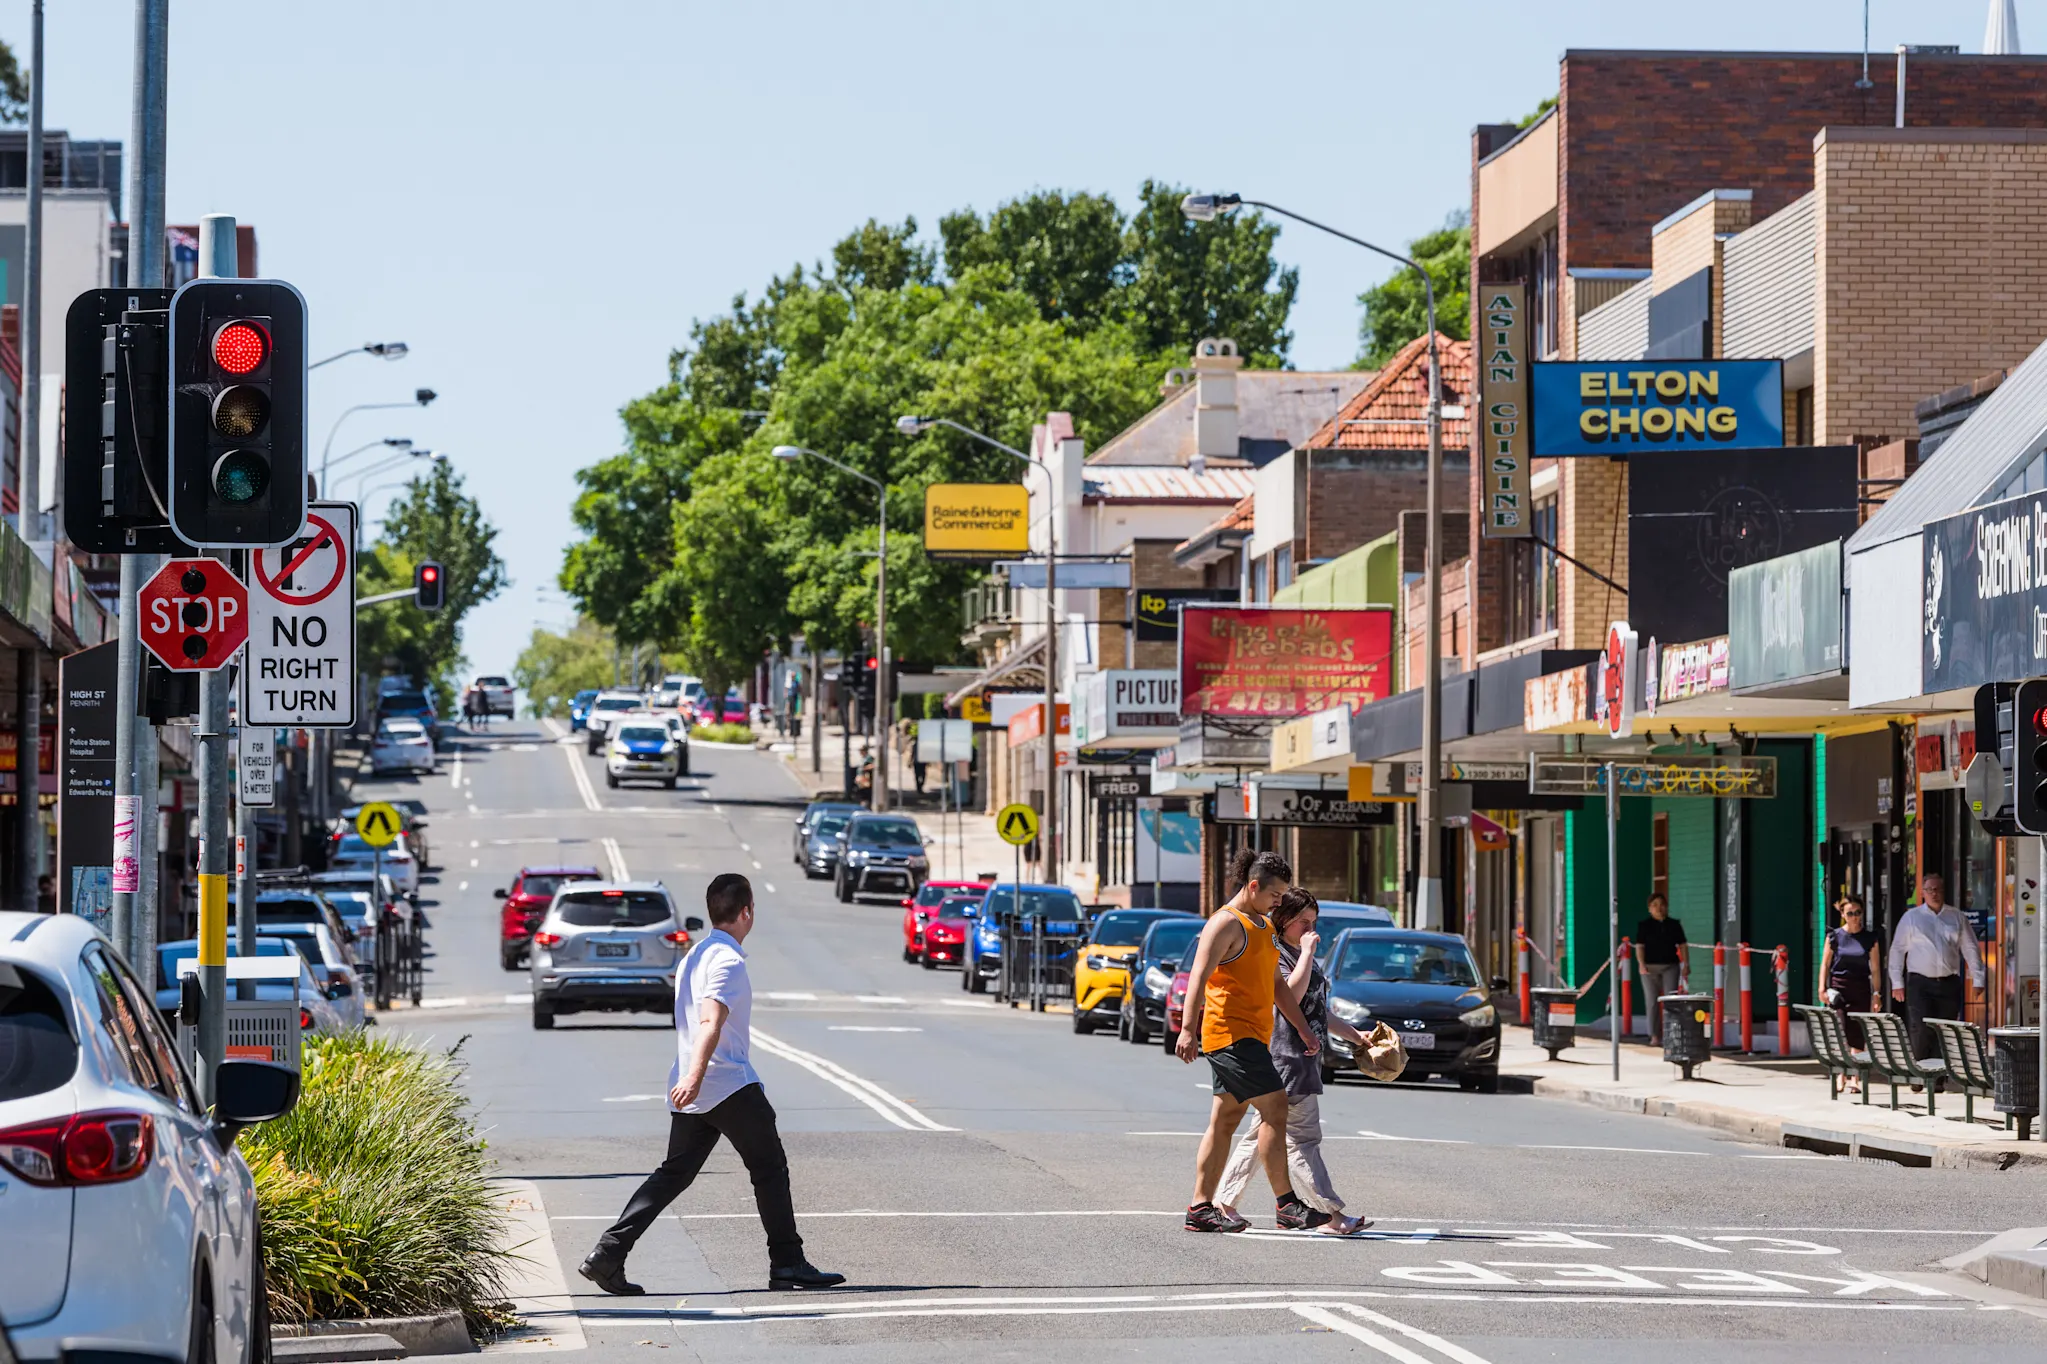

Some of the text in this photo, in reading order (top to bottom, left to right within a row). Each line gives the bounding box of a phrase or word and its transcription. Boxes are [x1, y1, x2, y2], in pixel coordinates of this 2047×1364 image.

[1580, 371, 1719, 404] ELTON
[1486, 293, 1521, 528] ASIAN CUISINE
[1580, 406, 1737, 441] CHONG
[932, 517, 1014, 530] Commercial
[1977, 514, 2031, 599] SCREAMING
[150, 596, 239, 634] STOP
[273, 616, 327, 647] NO
[1236, 633, 1355, 662] Kebabs
[261, 658, 339, 679] RIGHT
[1203, 674, 1372, 688] FREE HOME DELIVERY
[70, 690, 106, 699] HIGH ST
[264, 690, 336, 711] TURN
[1227, 690, 1297, 712] 4731
[69, 738, 110, 746] Police Station
[69, 748, 94, 757] Hospital
[252, 743, 264, 752] FOR
[243, 756, 272, 766] VEHICLES
[250, 770, 266, 780] OVER
[69, 788, 113, 796] Edwards Place
[244, 781, 272, 794] 6 METRES
[1380, 1260, 1952, 1297] KEEP
